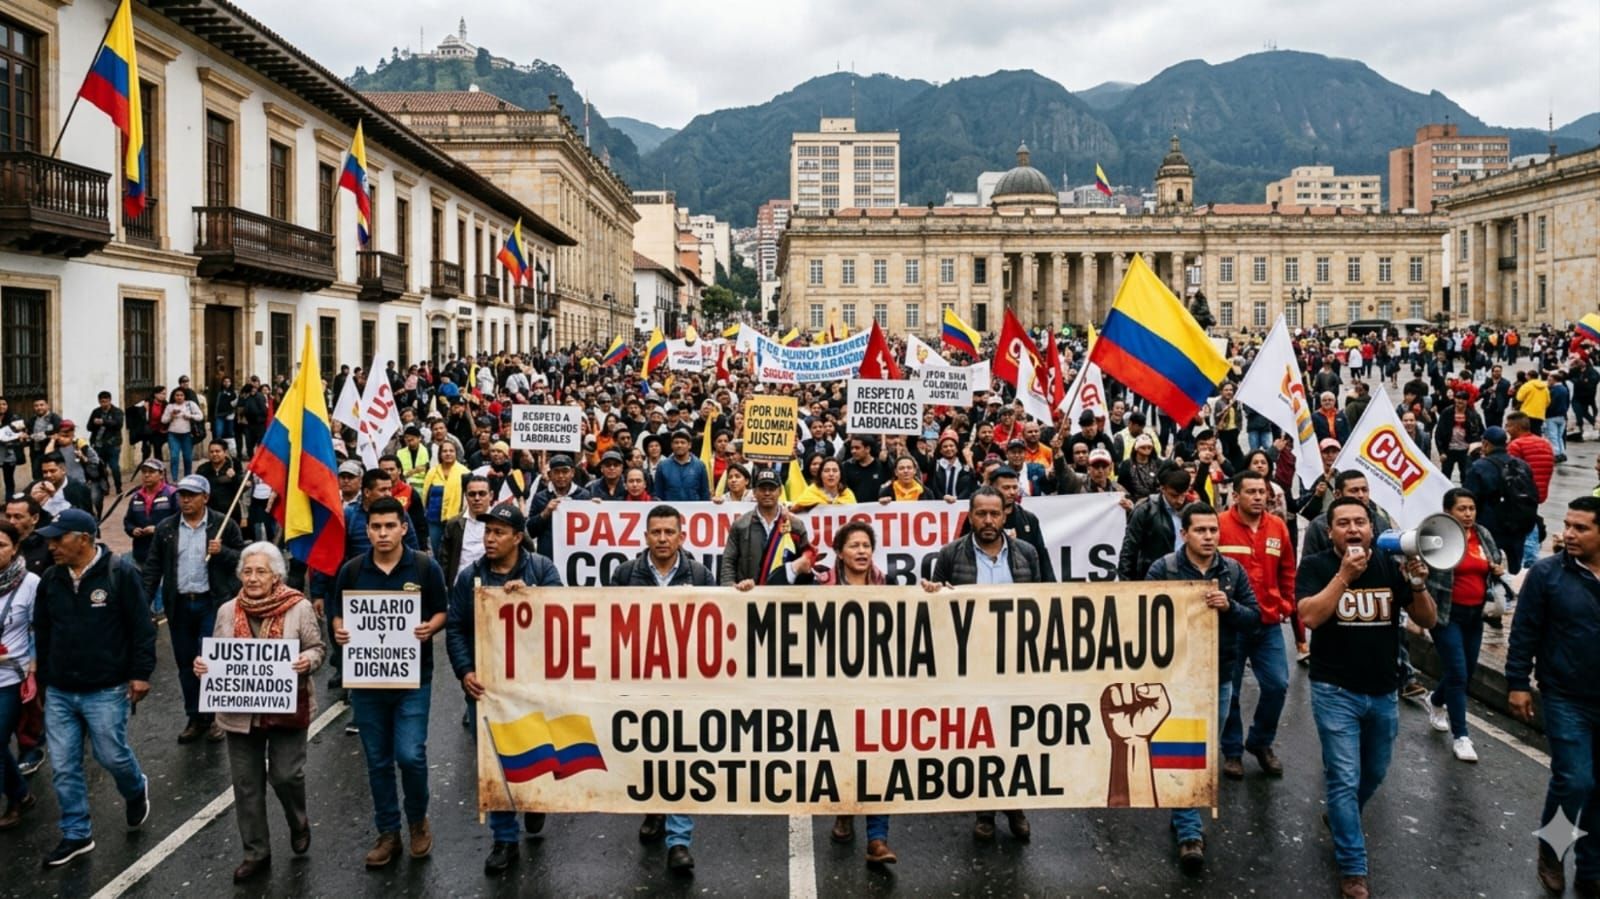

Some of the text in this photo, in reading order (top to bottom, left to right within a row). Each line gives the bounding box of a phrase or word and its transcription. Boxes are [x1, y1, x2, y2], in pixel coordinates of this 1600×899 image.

[858, 387, 915, 400] RESPETO A
[563, 413, 570, 422] A
[774, 406, 794, 418] UNA
[851, 416, 919, 430] LABORALES
[520, 433, 571, 444] LABORALES
[1368, 431, 1423, 485] CUT
[566, 511, 641, 547] PAZ
[350, 599, 414, 614] SALARIO
[1338, 589, 1391, 620] CUT
[357, 616, 406, 631] JUSTO
[378, 634, 386, 644] Y
[544, 604, 597, 680] DE
[610, 602, 737, 680] MAYO:
[746, 600, 937, 678] MEMORIA
[950, 599, 976, 677] Y
[989, 593, 1175, 674] TRABAJO
[209, 643, 291, 661] JUSTICIA
[348, 647, 416, 660] PENSIONES
[226, 664, 274, 676] POR LOS
[354, 662, 409, 677] DIGNAS
[205, 678, 293, 693] ASESINADOS
[207, 695, 290, 709] (MEMORIAVIVA)
[612, 703, 1091, 753] COLOMBIA LUCHA POR
[627, 753, 1064, 803] JUSTICIA LABORAL
